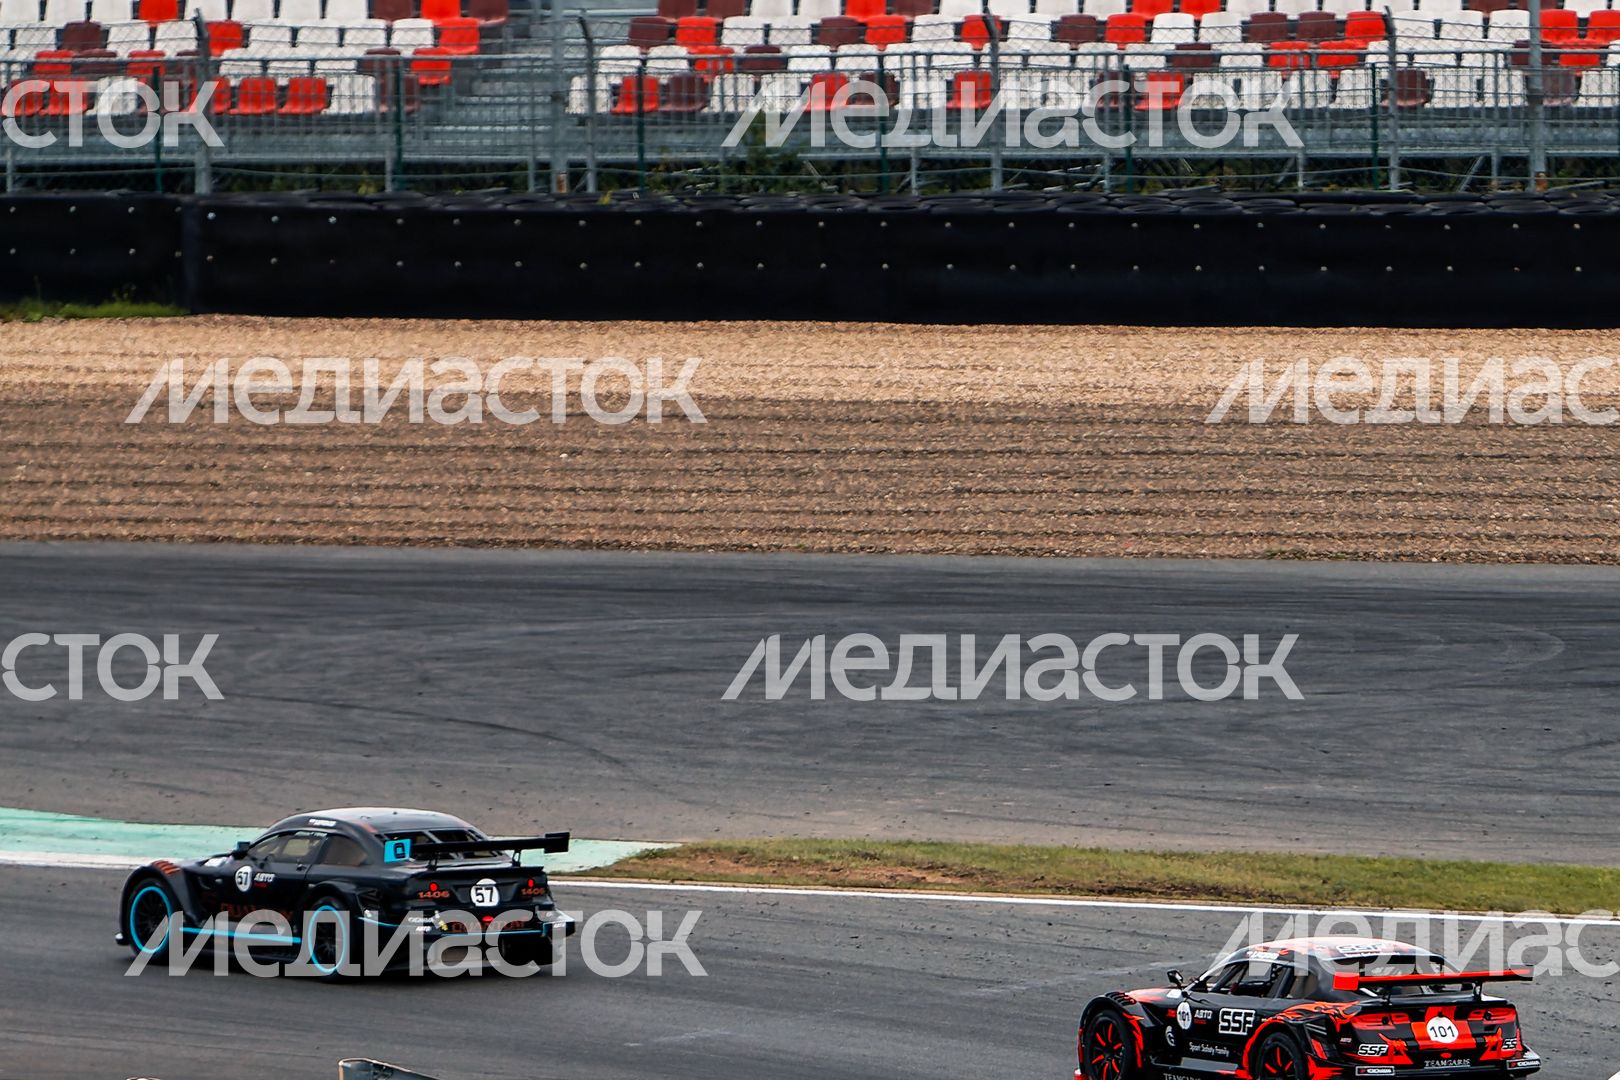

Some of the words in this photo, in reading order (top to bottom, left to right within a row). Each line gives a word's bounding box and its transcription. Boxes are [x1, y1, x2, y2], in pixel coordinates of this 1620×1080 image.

[418, 891, 450, 899] 1406
[475, 887, 494, 904] 57
[1219, 1008, 1256, 1035] SSF
[1429, 1026, 1455, 1038] 101
[1358, 1044, 1389, 1056] SSF
